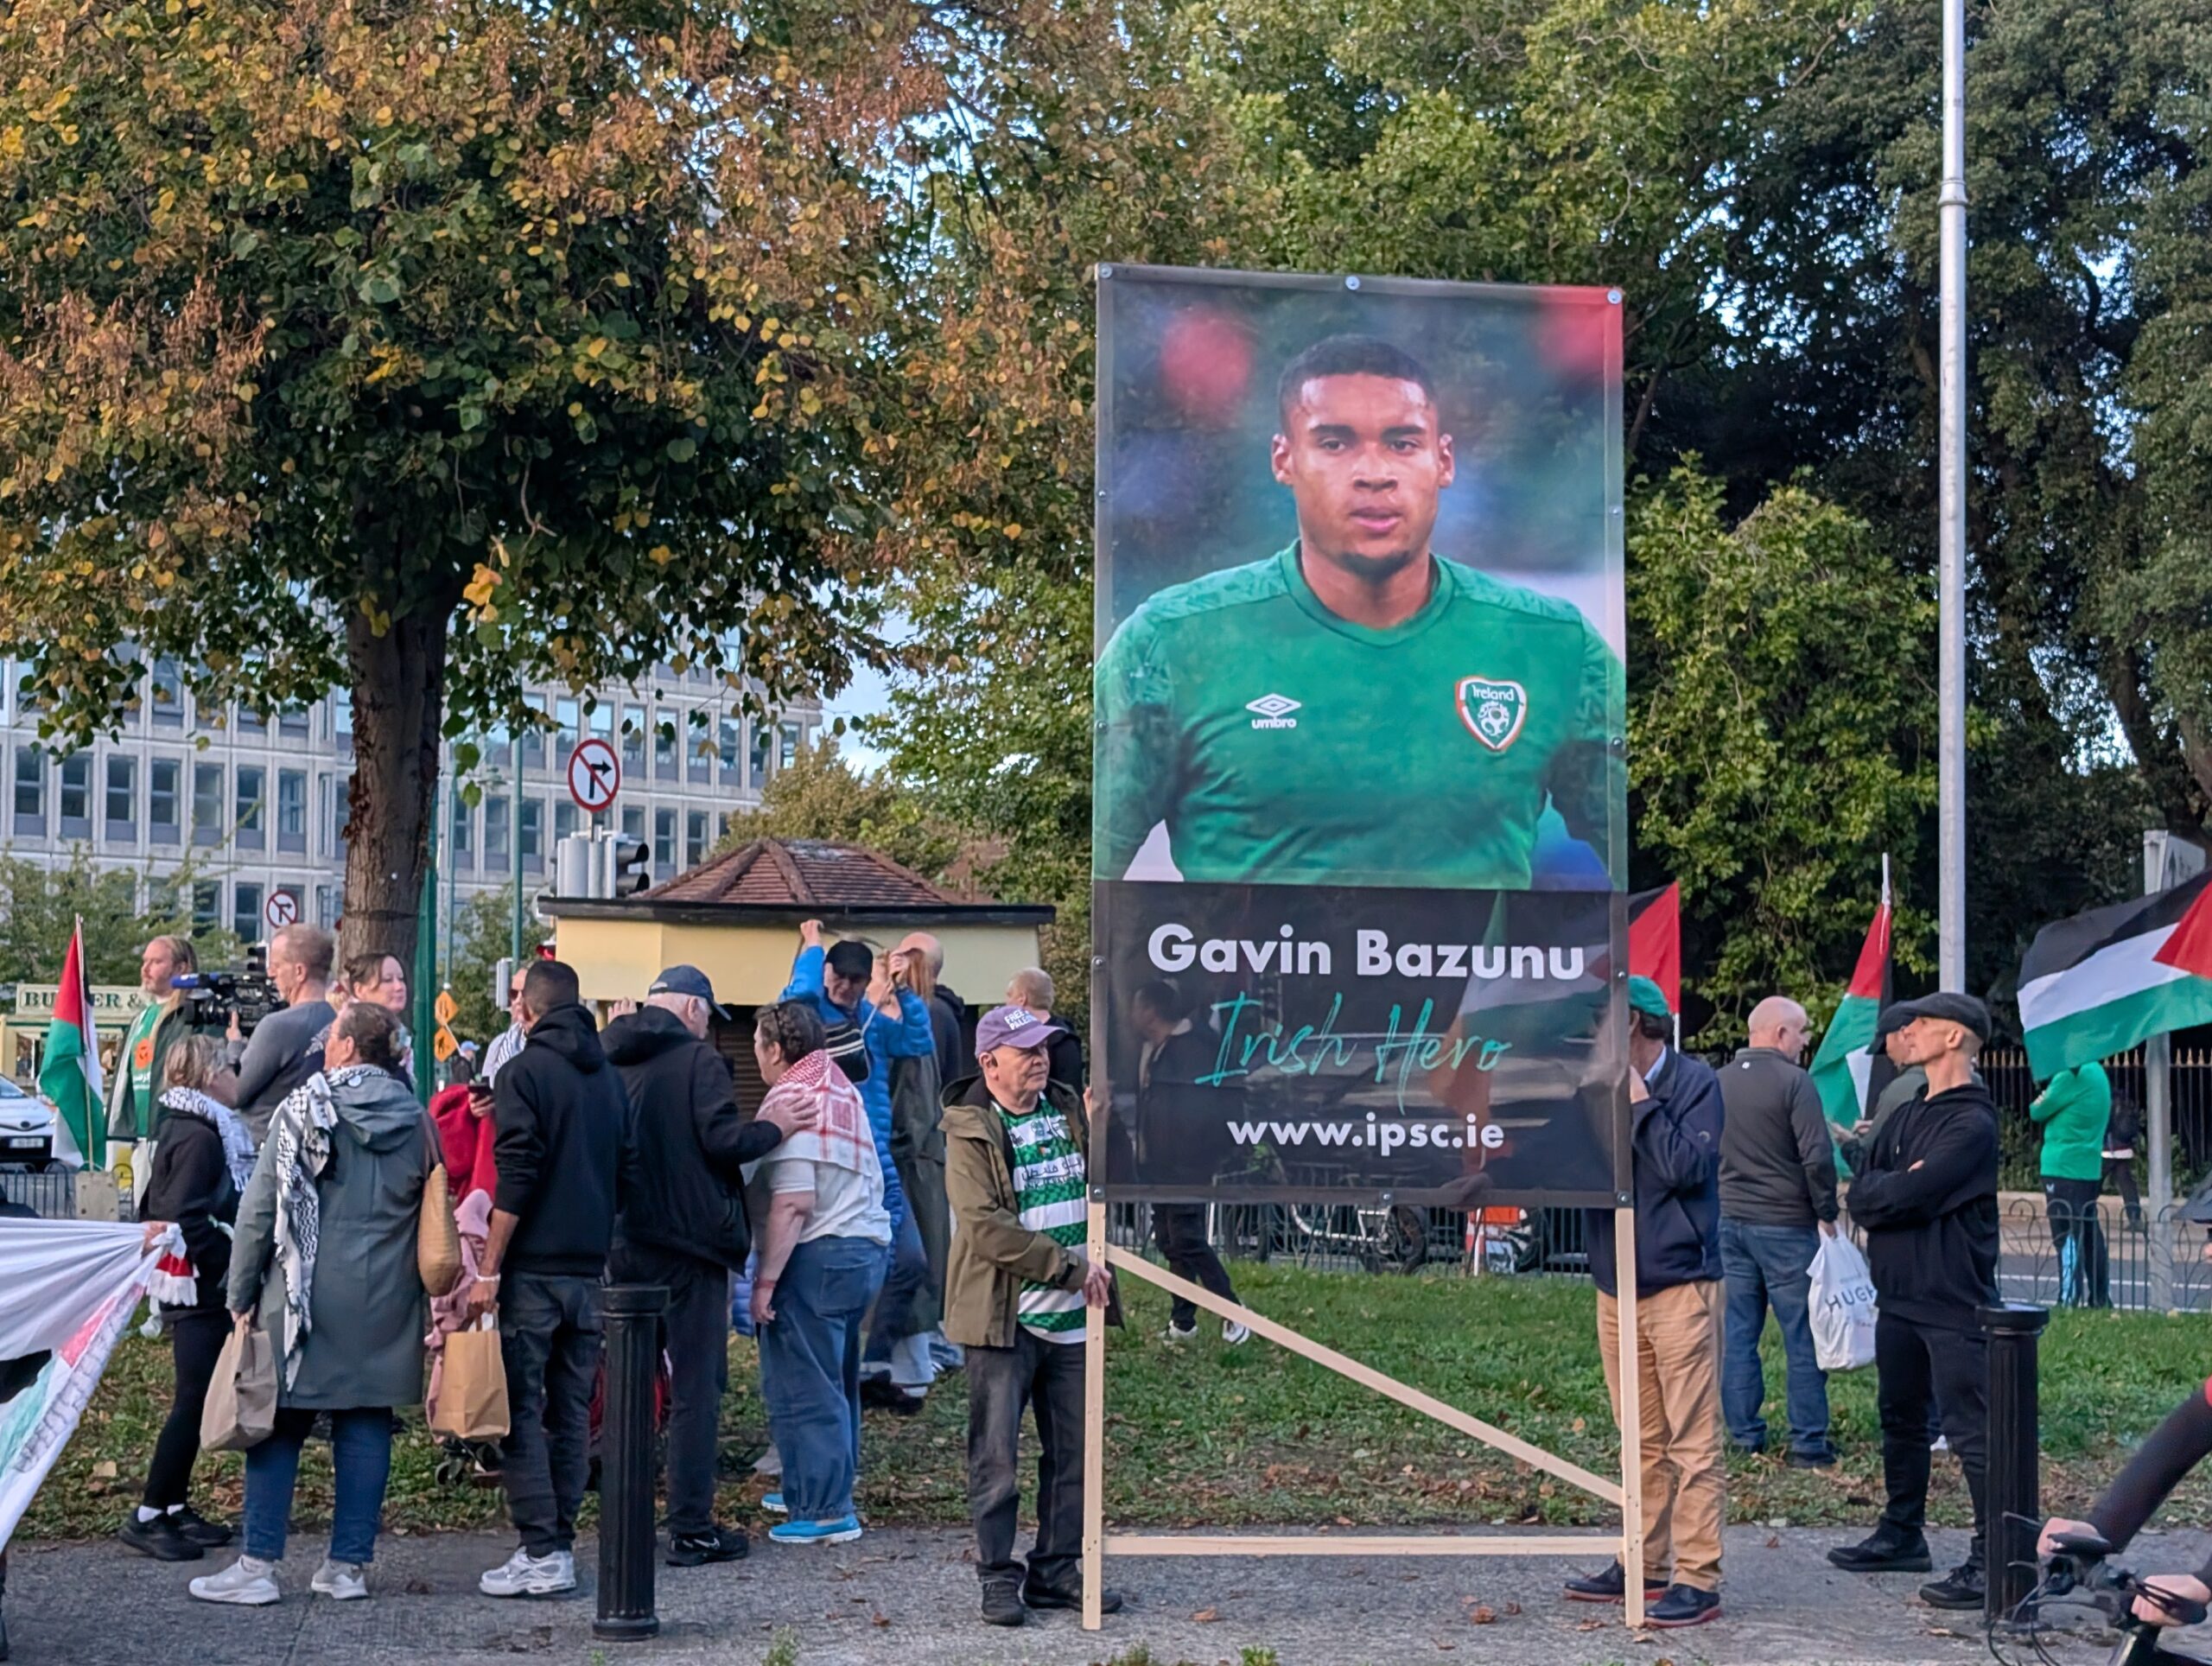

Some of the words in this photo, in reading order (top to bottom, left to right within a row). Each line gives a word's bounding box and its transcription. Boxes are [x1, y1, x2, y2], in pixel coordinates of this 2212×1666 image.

[1471, 684, 1515, 702] Ireland
[1251, 715, 1297, 730] umbro
[1147, 923, 1332, 975] Gavin
[1356, 929, 1585, 981] Bazunu
[24, 991, 123, 1008] BUER
[1004, 1008, 1026, 1026] FREE
[1195, 990, 1356, 1087] Irish
[1375, 997, 1513, 1116] Hero
[1227, 1111, 1505, 1156] www.ipsc.ie
